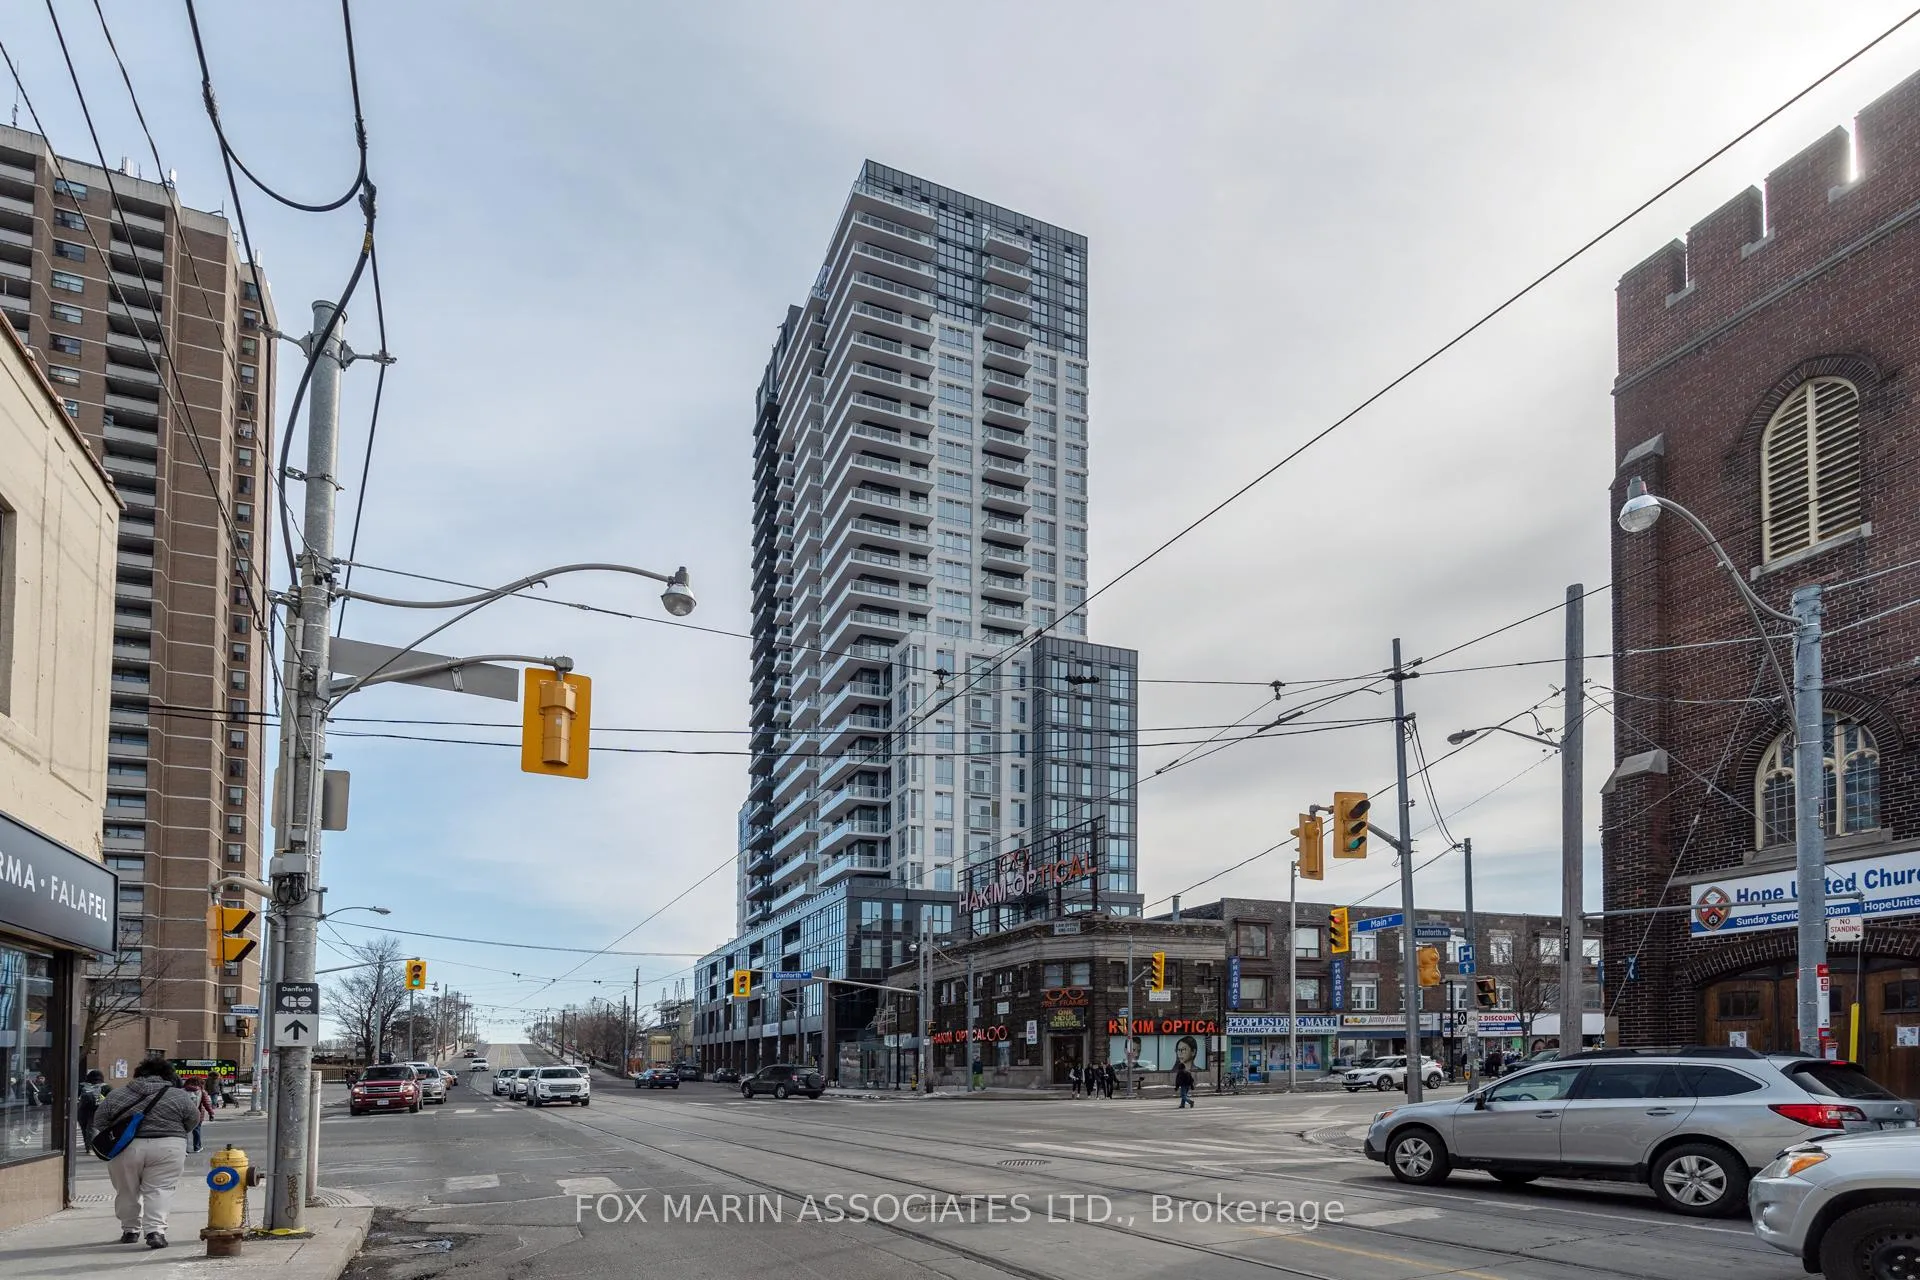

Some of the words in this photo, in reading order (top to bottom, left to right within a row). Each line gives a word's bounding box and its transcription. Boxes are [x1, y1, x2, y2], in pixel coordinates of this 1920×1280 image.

[959, 880, 1006, 914] HAKIM
[1012, 851, 1097, 897] OPTICAL
[1736, 886, 1784, 906] Hope
[1791, 872, 1856, 898] Uted
[51, 875, 107, 922] FALAFEL
[1370, 919, 1387, 928] Main
[1736, 912, 1769, 926] Sunday
[1771, 910, 1799, 921] Servic
[1830, 925, 1861, 933] STANDING
[1108, 1020, 1155, 1034] HKIM
[1161, 1020, 1220, 1034] OPTICA
[1228, 1017, 1275, 1027] PEOPLES
[1276, 1017, 1304, 1027] DRG
[1305, 1017, 1336, 1027] MART
[955, 1029, 987, 1042] OPTCAL
